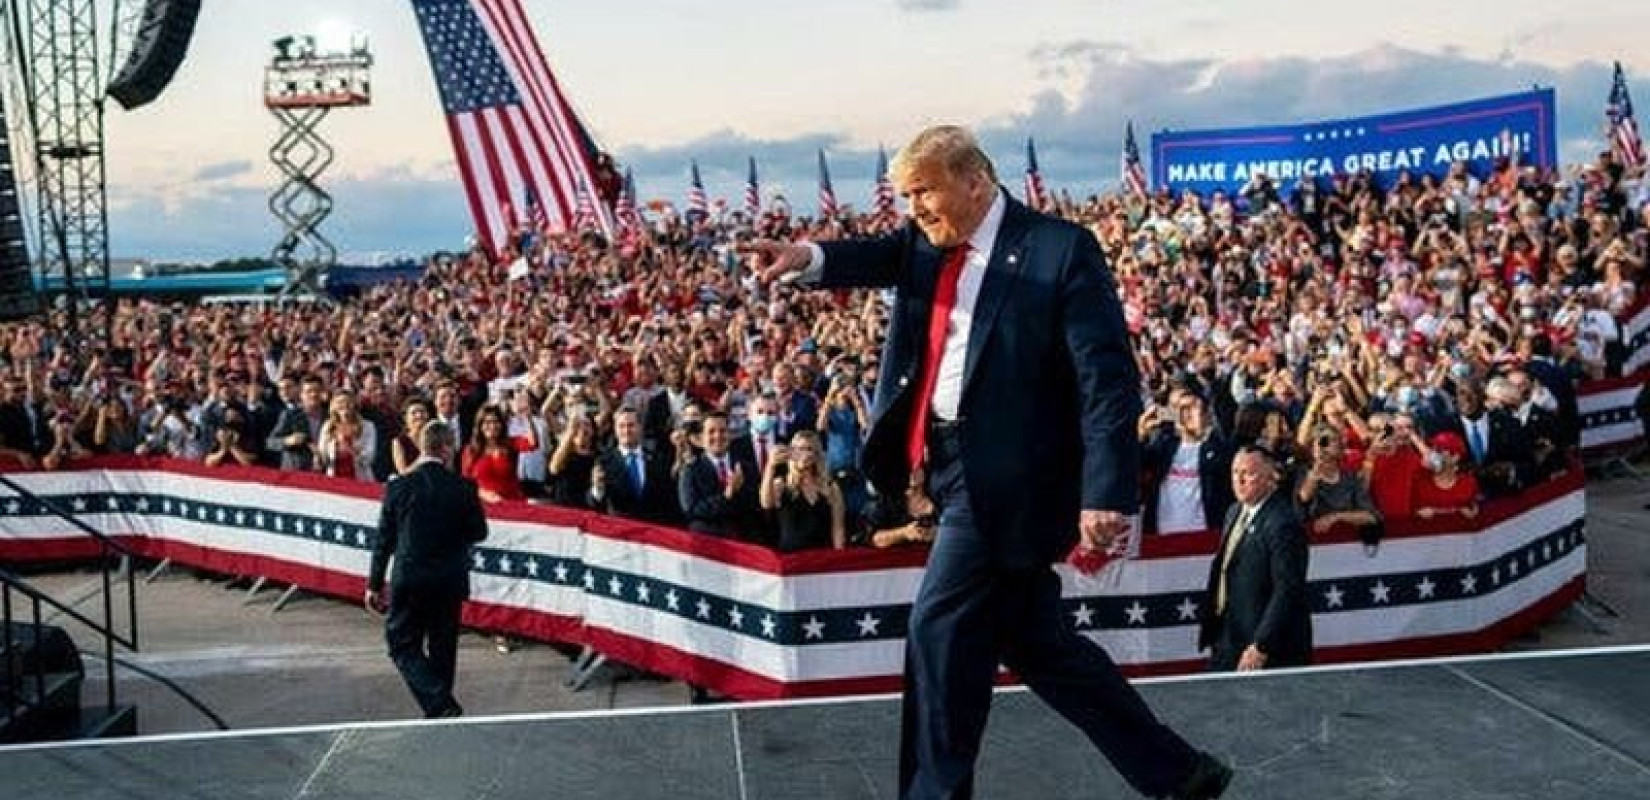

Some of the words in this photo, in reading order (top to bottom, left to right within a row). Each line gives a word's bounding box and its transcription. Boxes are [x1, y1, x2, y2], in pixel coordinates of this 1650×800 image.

[1168, 163, 1226, 182] MAKE
[1234, 157, 1335, 181] AMERICA
[1343, 147, 1425, 173] GREAT
